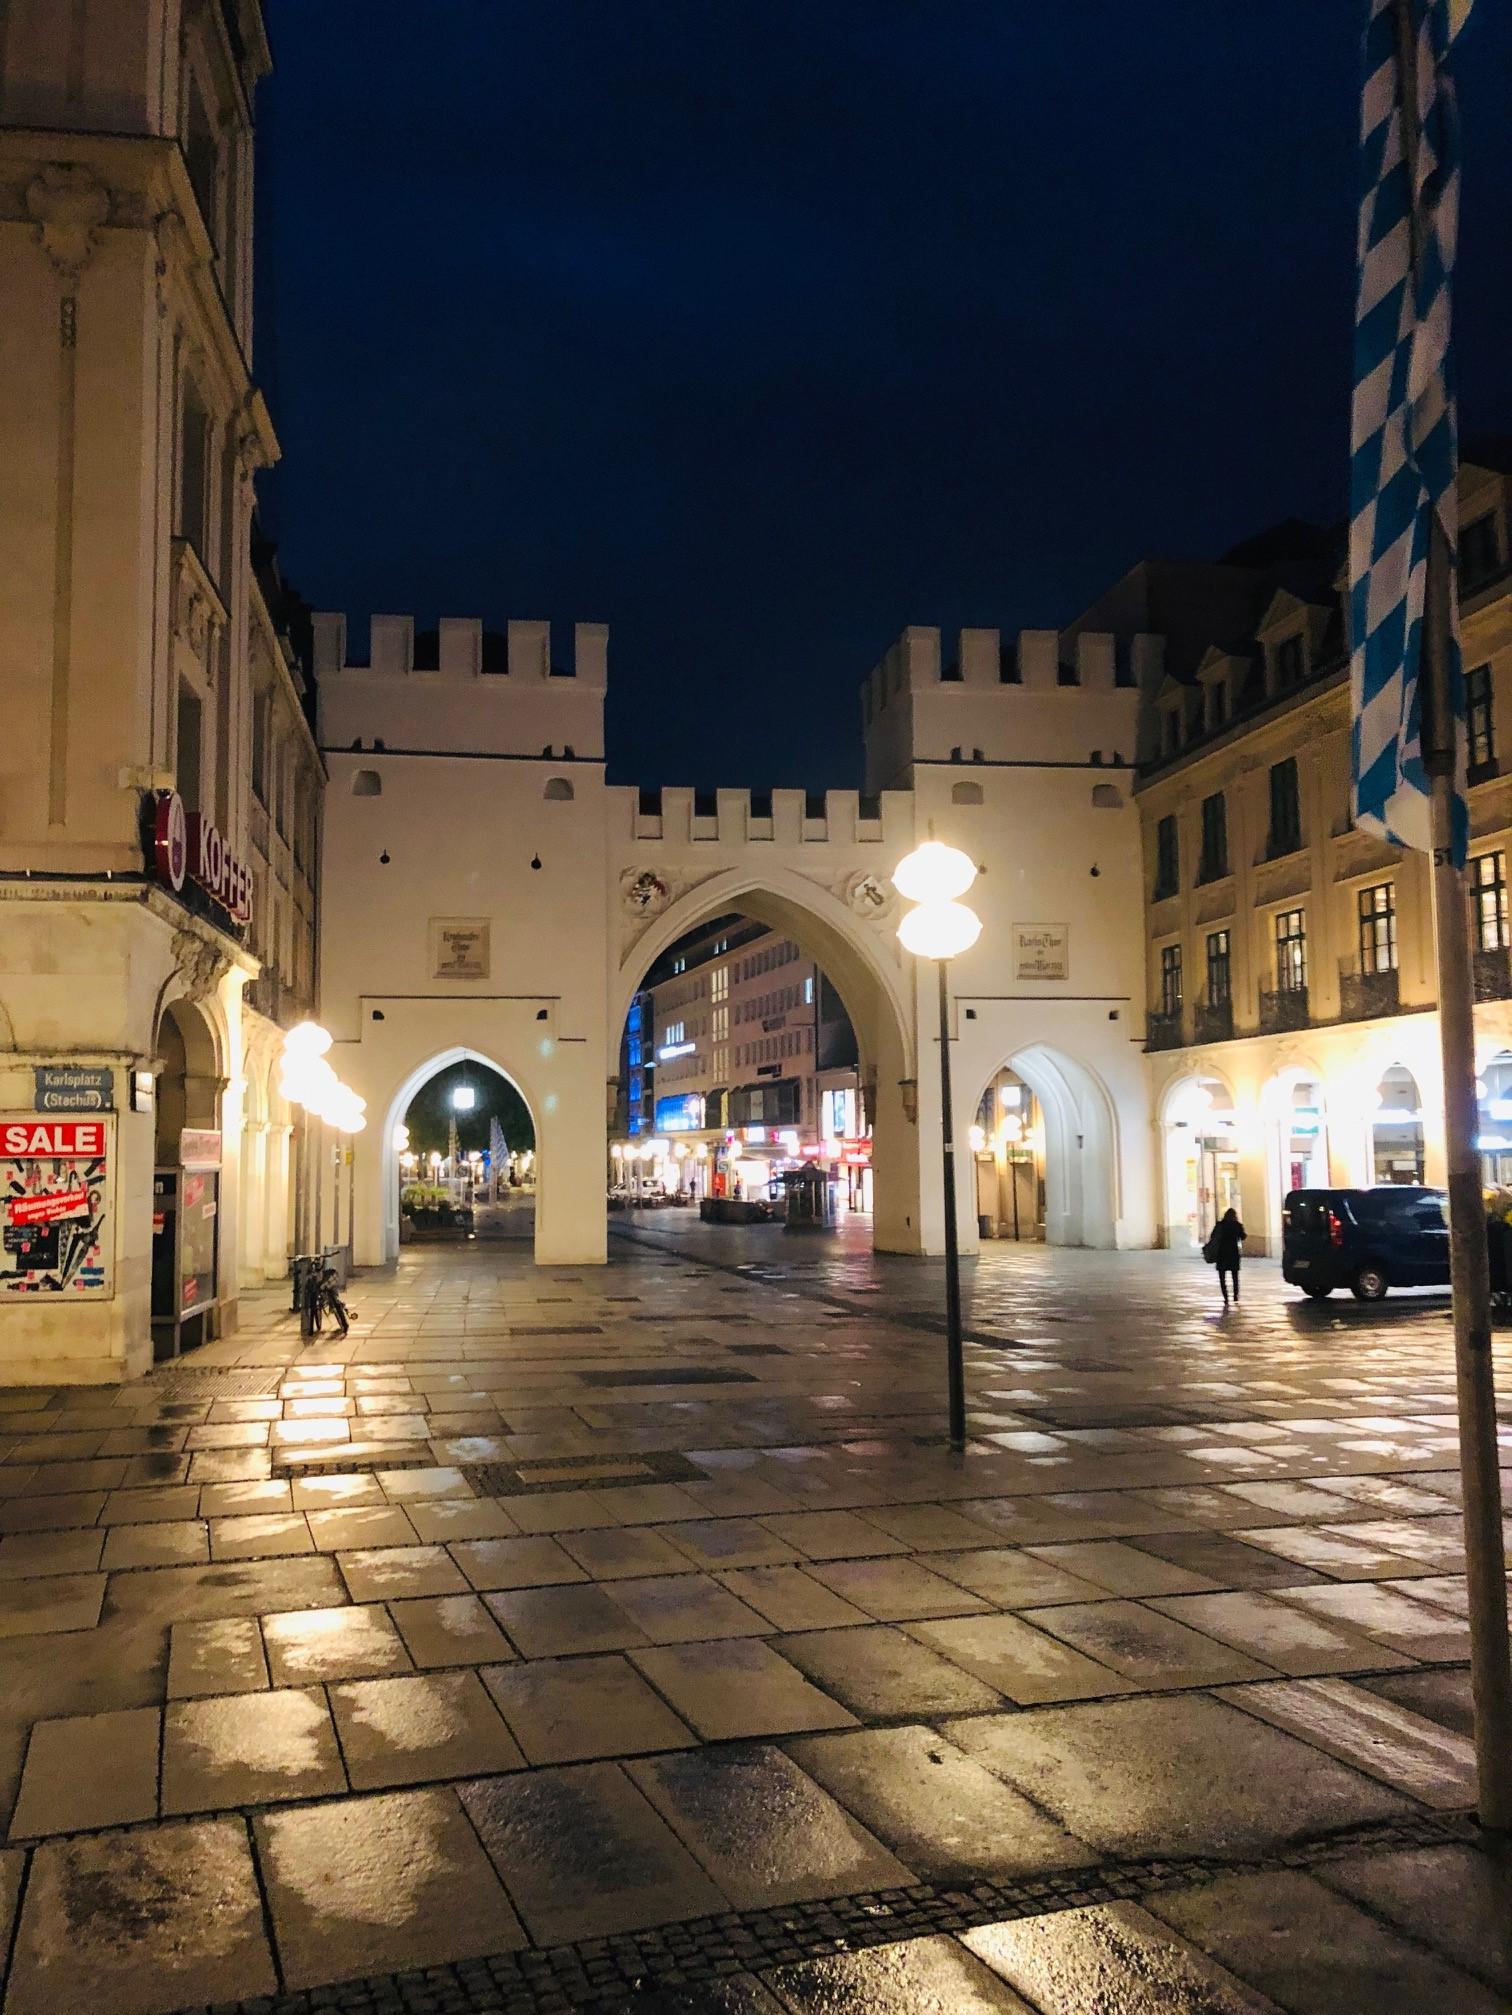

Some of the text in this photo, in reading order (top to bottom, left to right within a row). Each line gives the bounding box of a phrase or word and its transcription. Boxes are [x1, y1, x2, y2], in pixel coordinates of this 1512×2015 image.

[200, 813, 253, 919] KOFFER
[45, 1073, 102, 1088] Karlsplatz
[44, 1091, 102, 1109] (Stachus)
[5, 1126, 97, 1153] SALE
